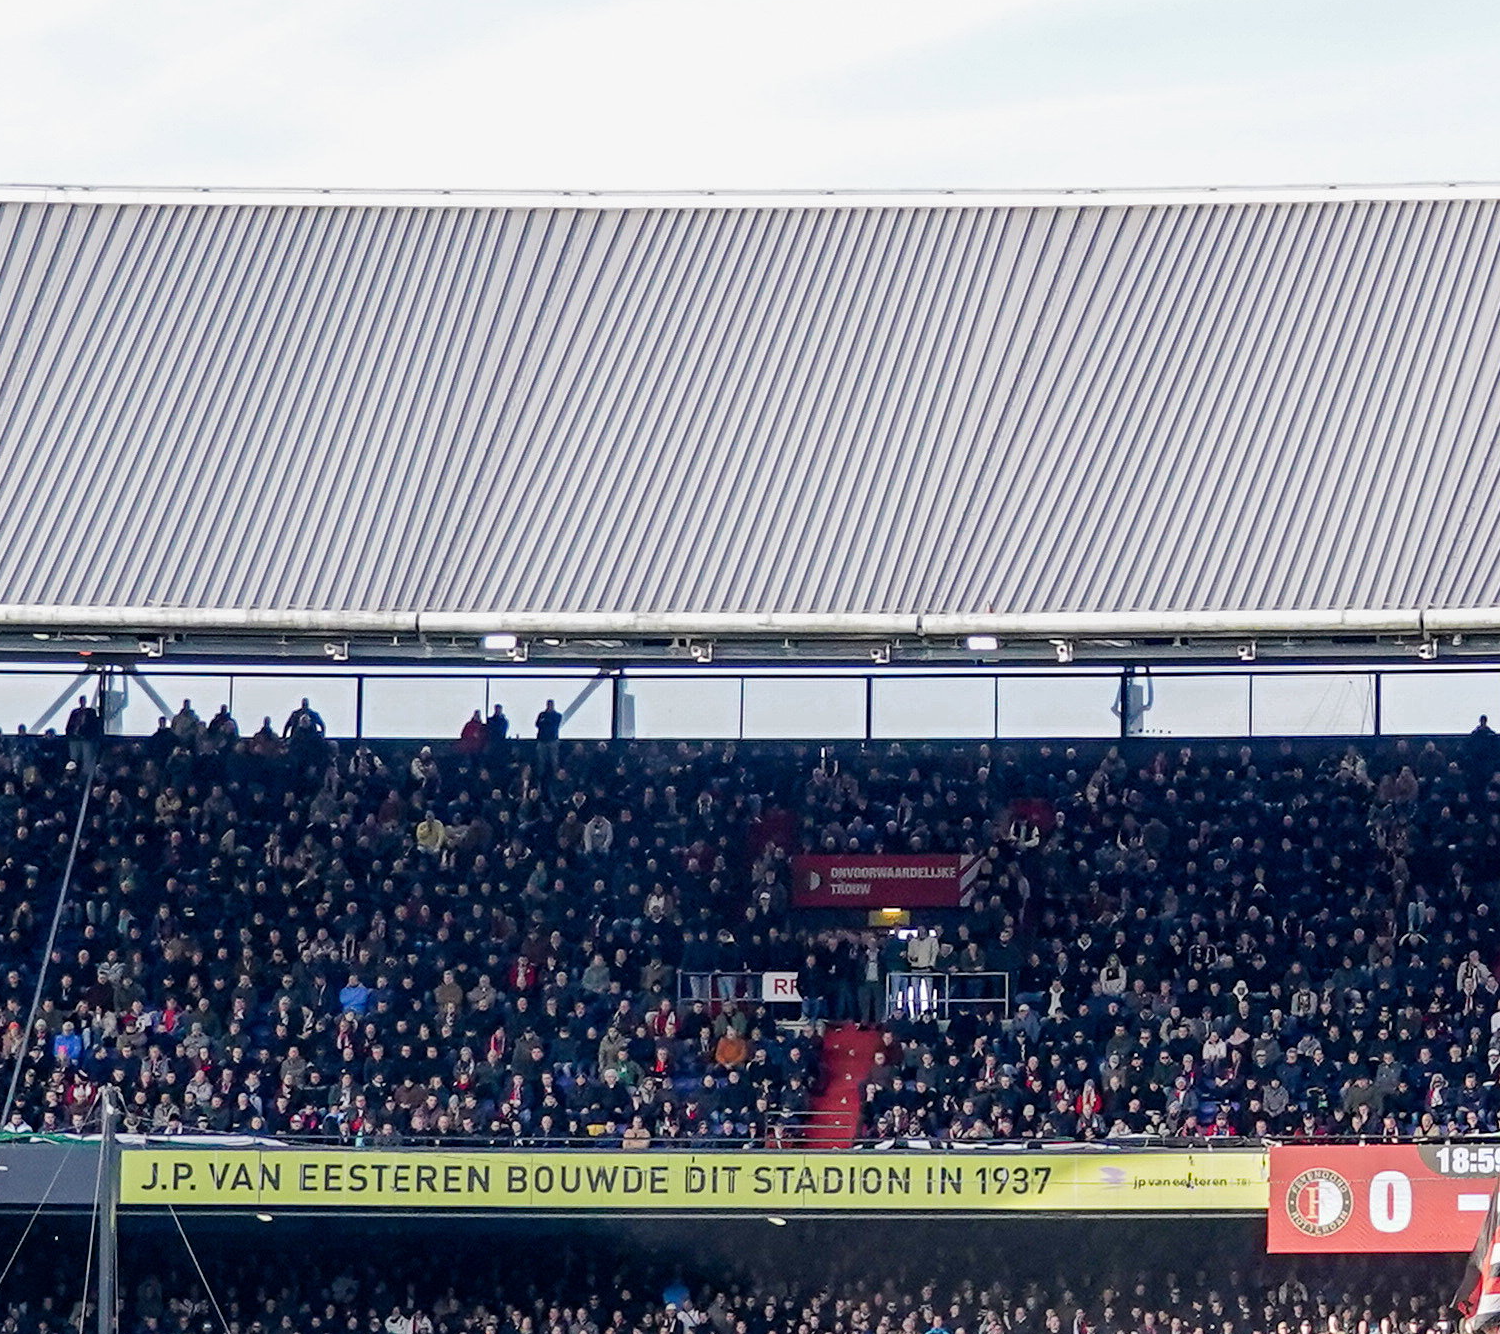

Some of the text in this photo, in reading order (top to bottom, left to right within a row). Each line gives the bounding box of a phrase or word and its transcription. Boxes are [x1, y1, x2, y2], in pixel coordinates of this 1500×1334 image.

[830, 883, 871, 895] TROUW
[141, 1162, 1052, 1195] J.P. VAN EESTEREN BOUWDE DIT STADION IN 1937
[1369, 1170, 1412, 1233] 0
